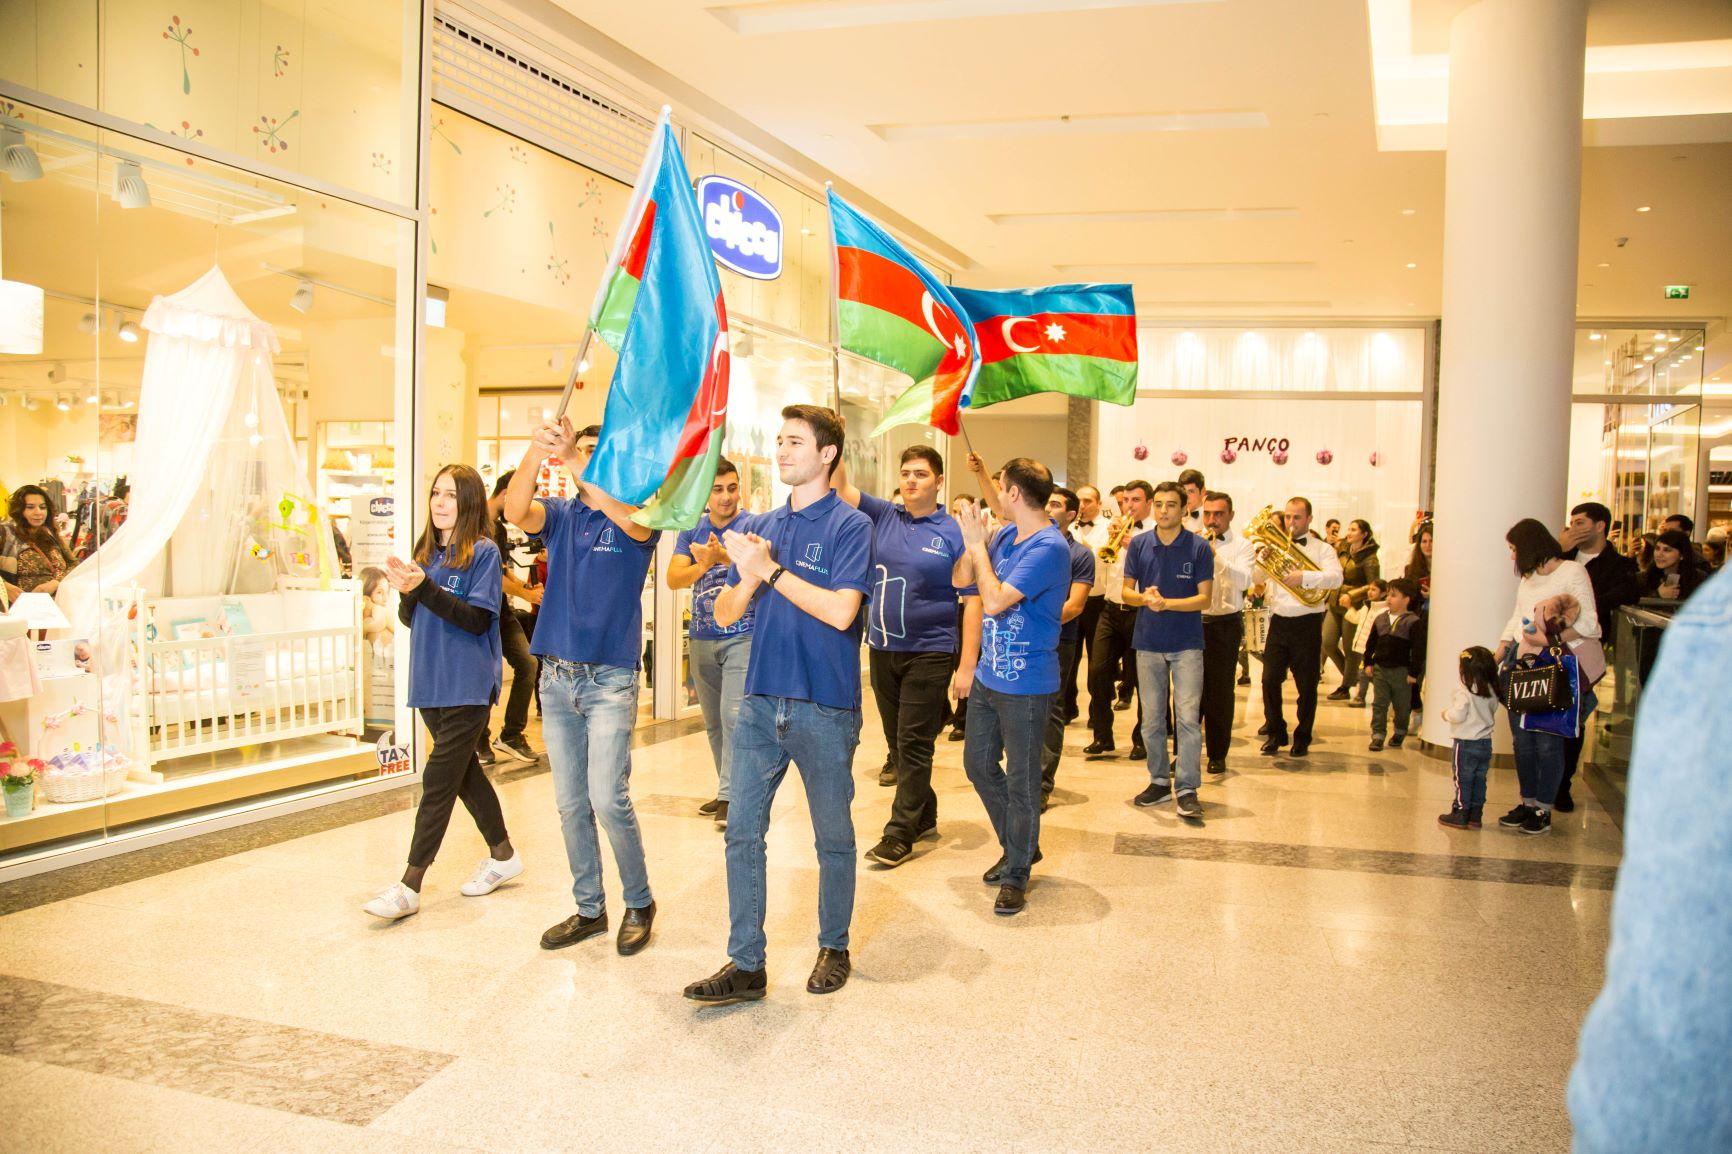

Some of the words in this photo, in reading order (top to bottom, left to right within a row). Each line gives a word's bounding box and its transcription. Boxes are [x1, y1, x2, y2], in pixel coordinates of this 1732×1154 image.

[705, 193, 778, 263] chicco
[1224, 437, 1289, 454] PANÇO
[795, 559, 829, 575] CINEMAPLUS
[1513, 678, 1549, 700] VLTN
[380, 744, 410, 764] TAX
[380, 759, 410, 776] FREE
